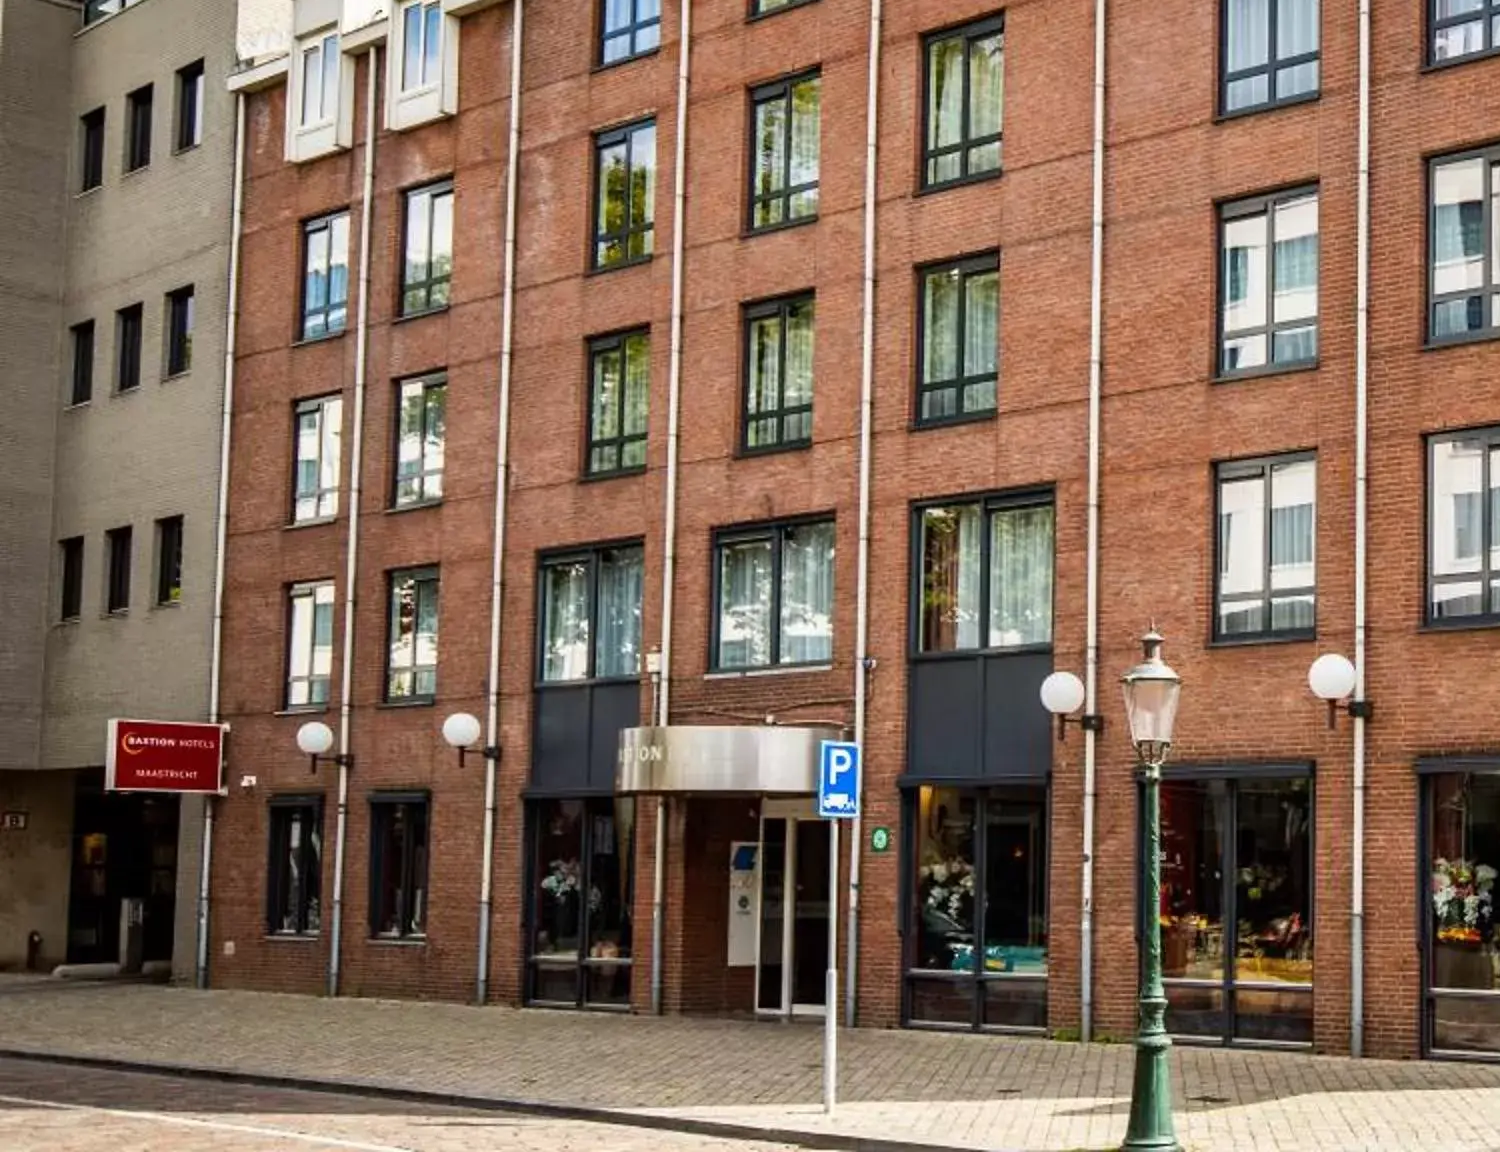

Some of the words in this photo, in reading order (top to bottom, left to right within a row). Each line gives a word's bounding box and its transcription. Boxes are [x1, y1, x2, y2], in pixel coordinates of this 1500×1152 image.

[127, 735, 175, 748] BASTION
[179, 739, 215, 750] HOTELS
[135, 768, 198, 780] MAASTRICHT
[829, 748, 852, 785] P
